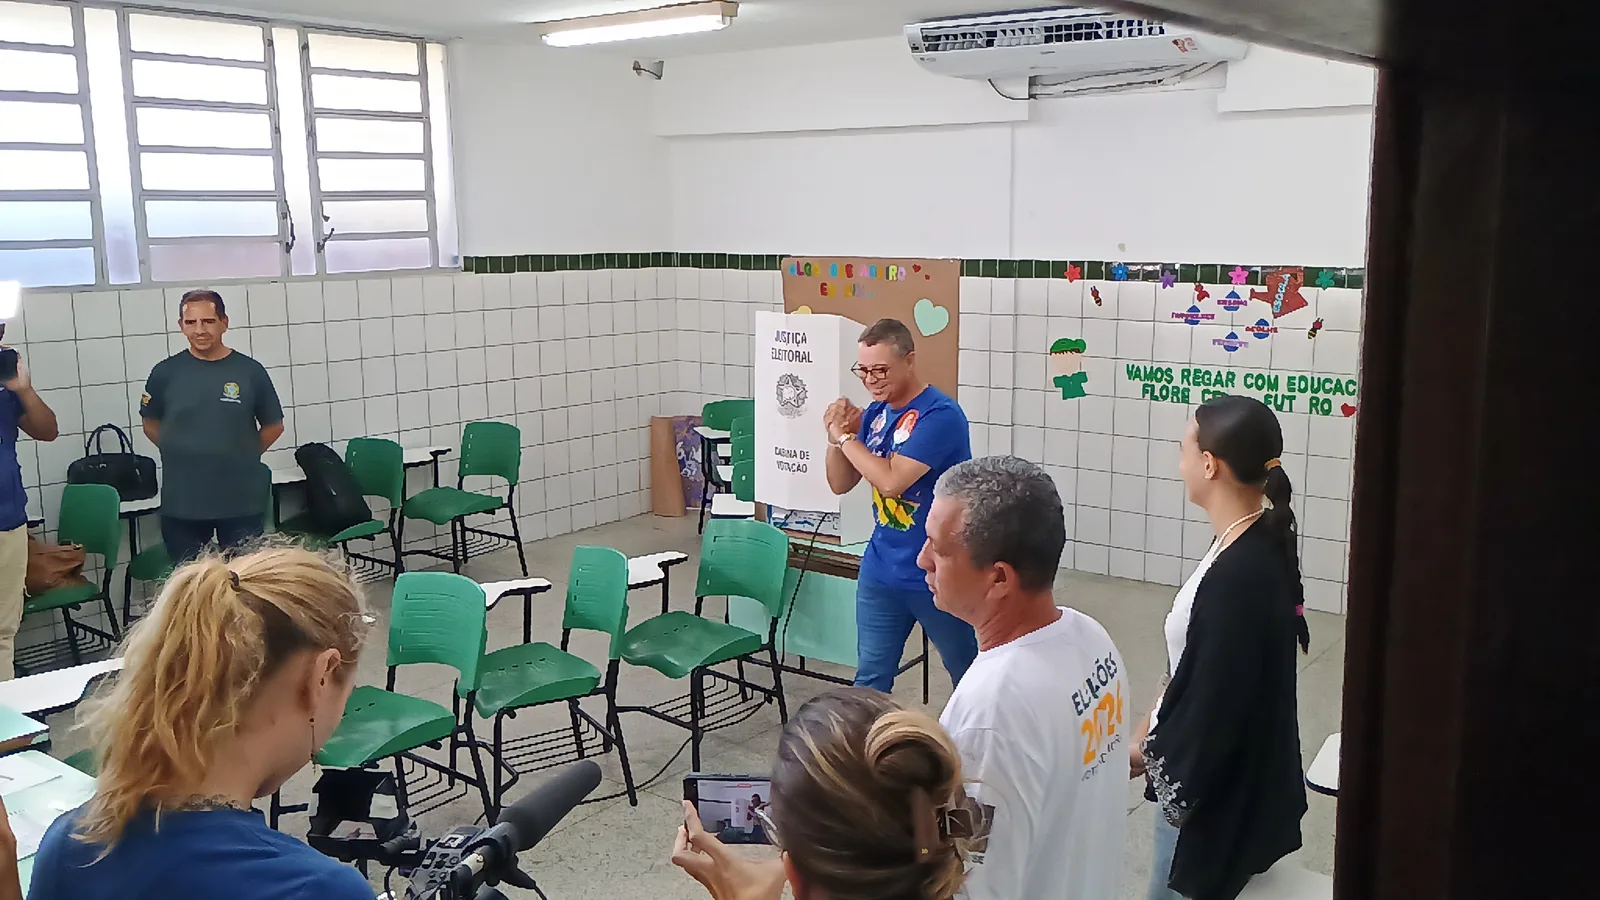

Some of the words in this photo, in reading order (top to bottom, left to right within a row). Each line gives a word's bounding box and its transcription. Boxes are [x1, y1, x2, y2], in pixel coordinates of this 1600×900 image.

[774, 330, 807, 347] JUSTIÇA
[771, 347, 813, 363] ELEITORAL
[1126, 363, 1174, 385] VAMOS
[1180, 368, 1236, 388] REGAR
[1243, 373, 1279, 392] COM
[799, 450, 810, 460] DE
